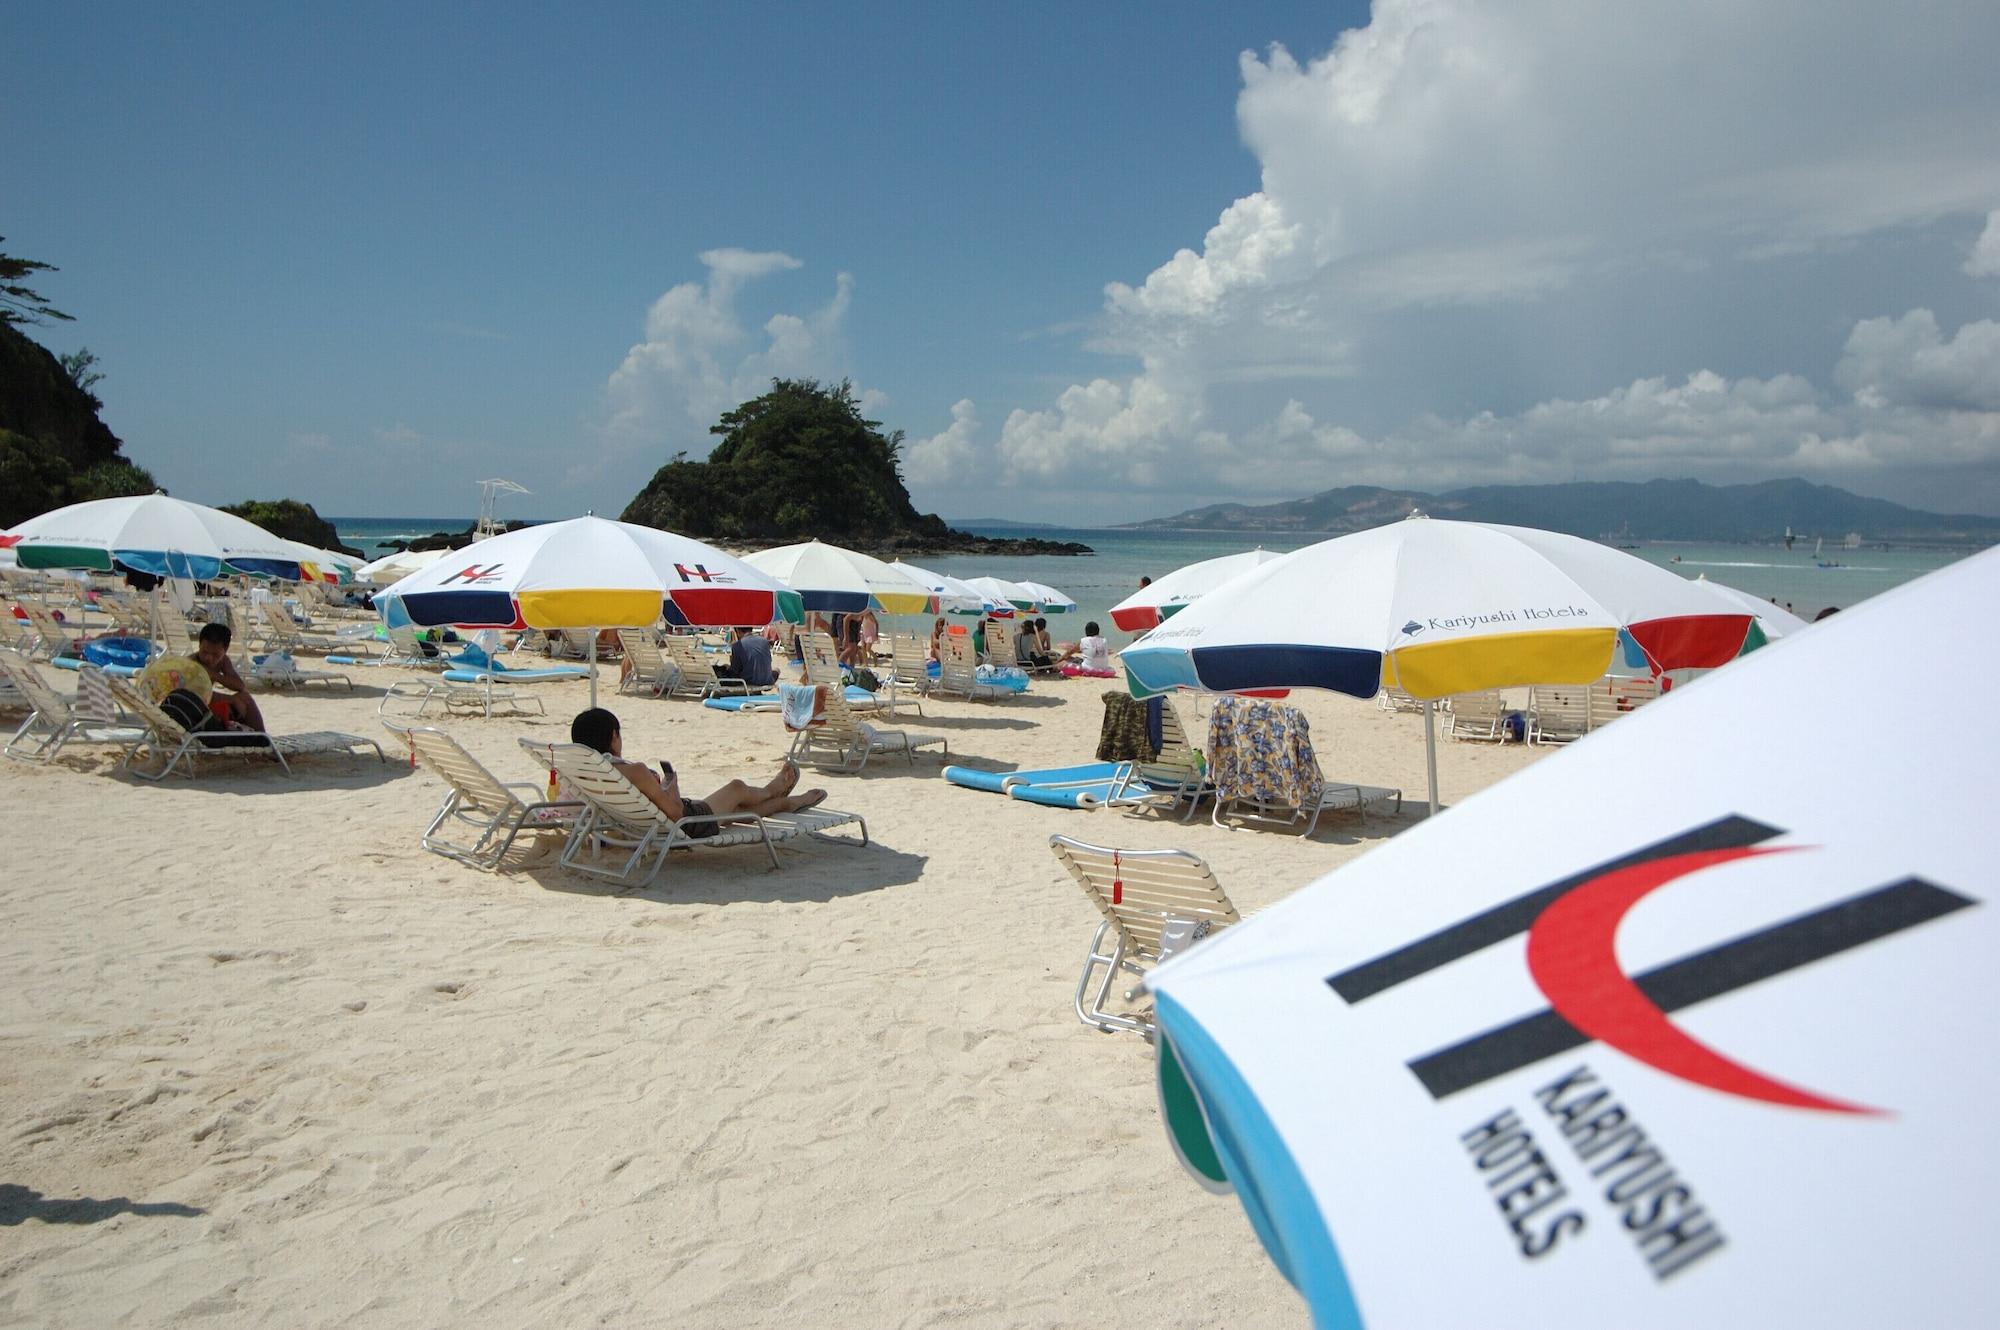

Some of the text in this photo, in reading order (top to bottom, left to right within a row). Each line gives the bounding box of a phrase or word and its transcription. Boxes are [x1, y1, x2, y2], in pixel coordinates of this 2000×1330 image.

[1428, 605, 1588, 631] Kariyushi Hotels
[1459, 1106, 1586, 1259] HOTELS
[1532, 1063, 1729, 1281] KARIYUSHI
